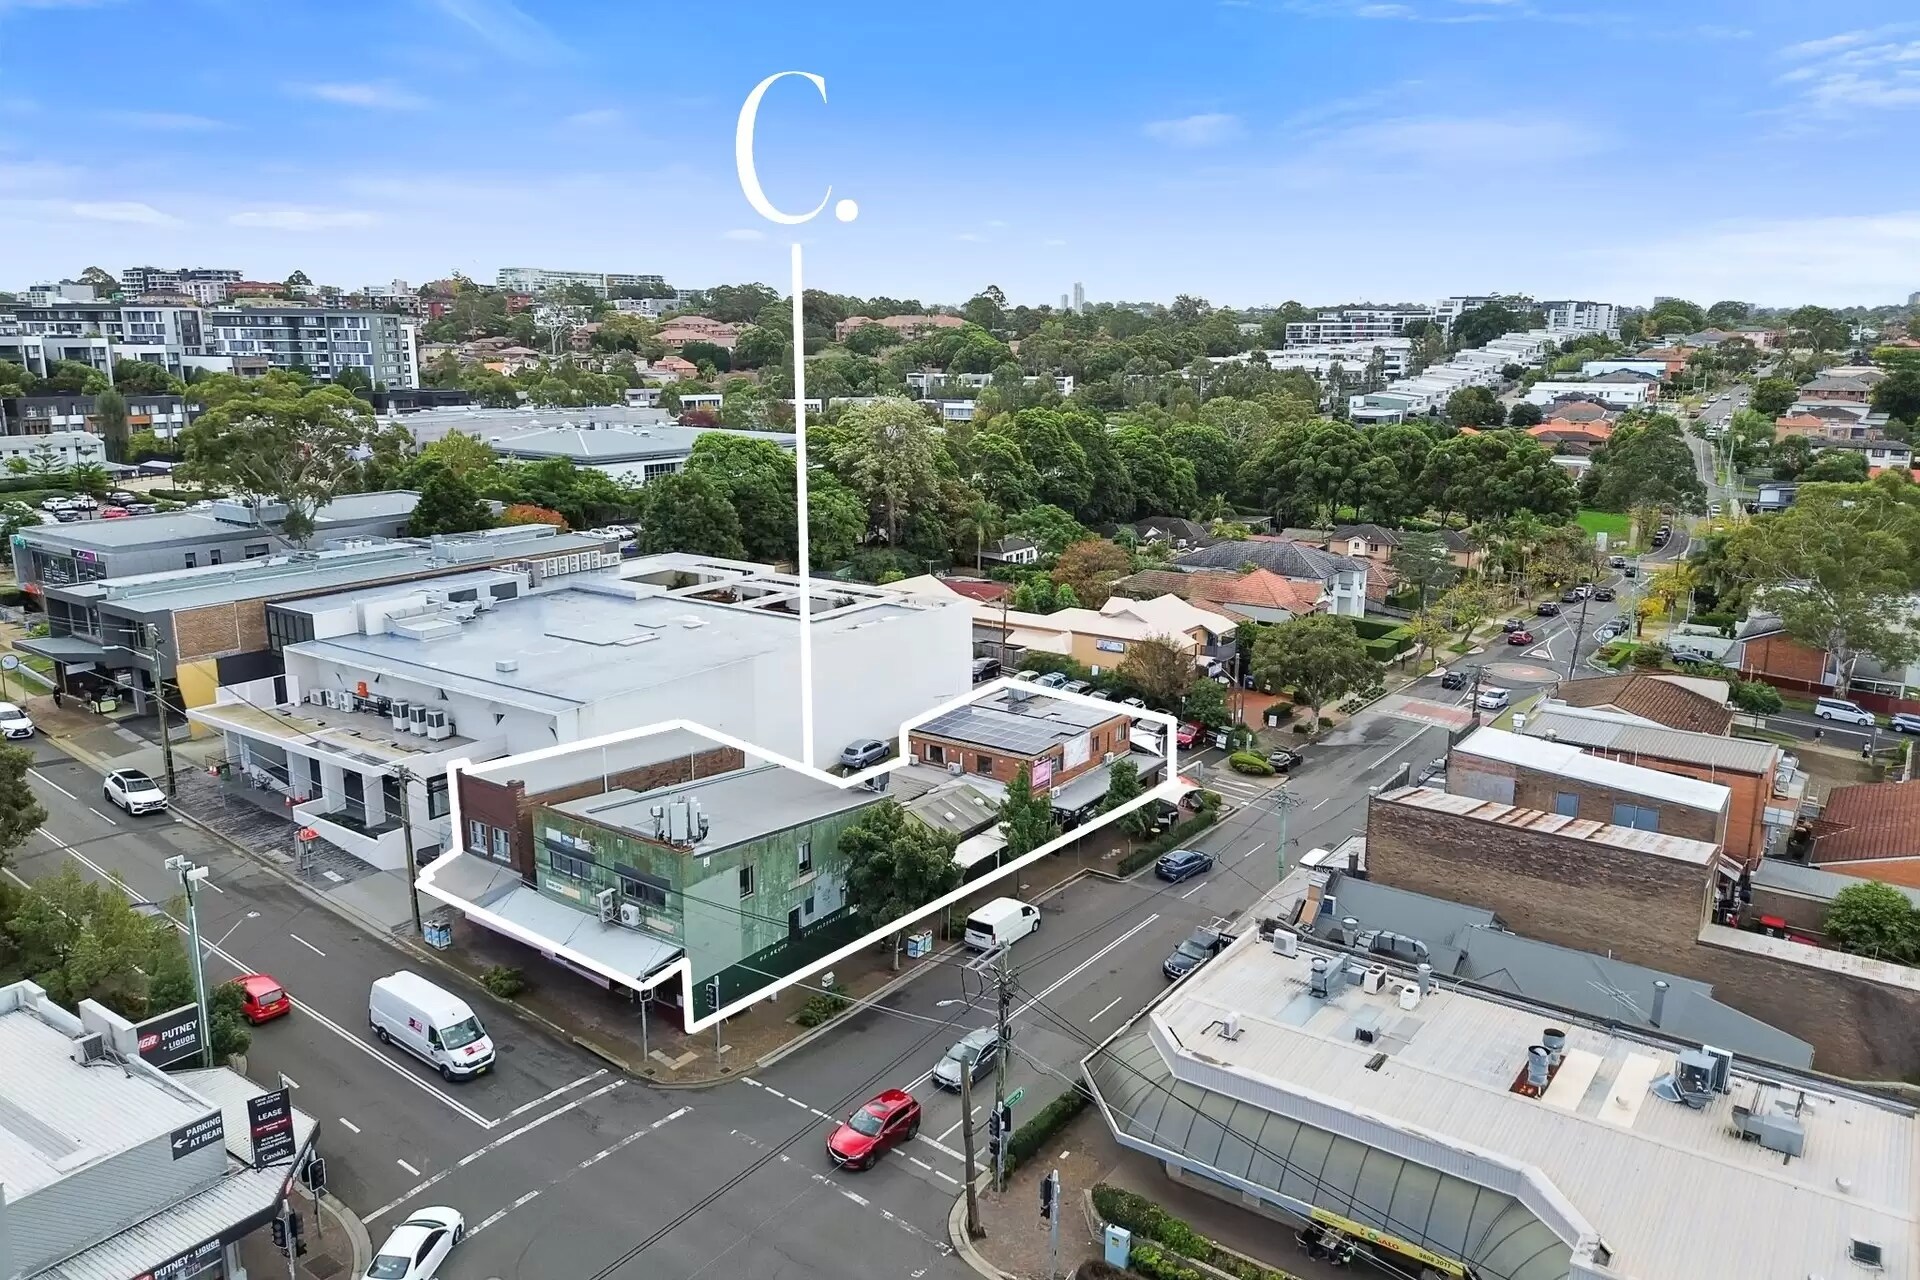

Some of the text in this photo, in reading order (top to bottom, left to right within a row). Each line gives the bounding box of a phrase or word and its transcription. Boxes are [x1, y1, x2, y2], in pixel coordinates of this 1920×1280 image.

[161, 1019, 198, 1041] PUTNEY
[168, 1033, 196, 1050] LIQUOR
[257, 1107, 283, 1121] LEASE
[186, 1116, 221, 1138] PARKING
[190, 1126, 223, 1148] AT REAR
[154, 1254, 189, 1279] PUTNEY
[195, 1238, 220, 1257] LIQUOR
